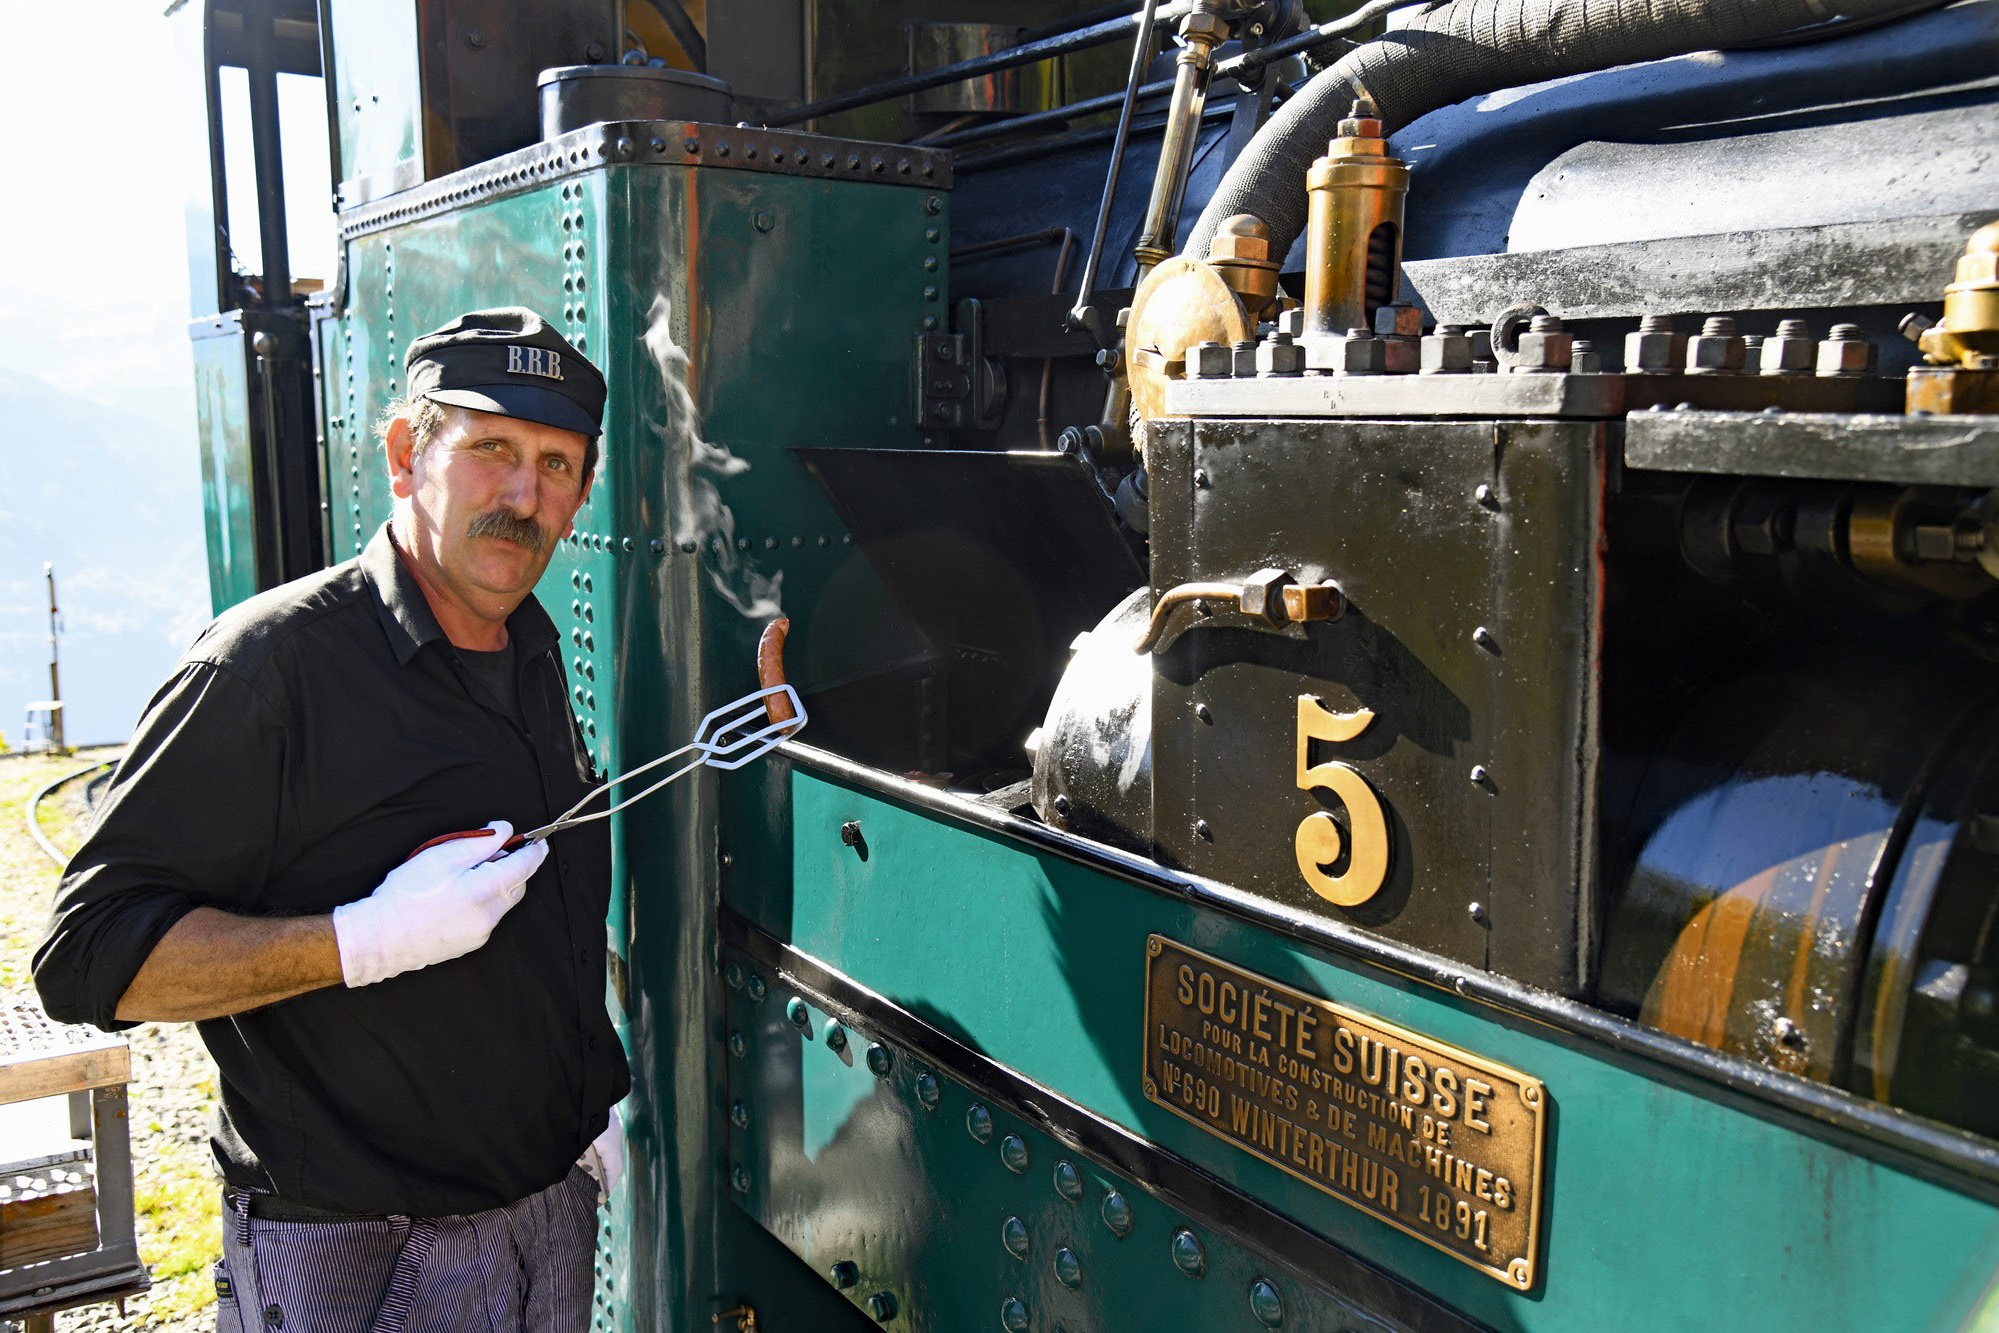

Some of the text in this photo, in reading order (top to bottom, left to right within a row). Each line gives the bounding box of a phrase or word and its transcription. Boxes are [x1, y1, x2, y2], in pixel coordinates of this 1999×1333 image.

[1295, 694, 1388, 906] 5
[1159, 1024, 1511, 1209] LOCOMOTIVES & DE MACHINES
[1178, 964, 1491, 1135] SOCIÉTÉ SUISSE
[1203, 1020, 1449, 1146] POUR LA CONSTRUCTION DE
[1231, 1094, 1398, 1211] WINTERTHUR
[1419, 1185, 1488, 1251] 1891
